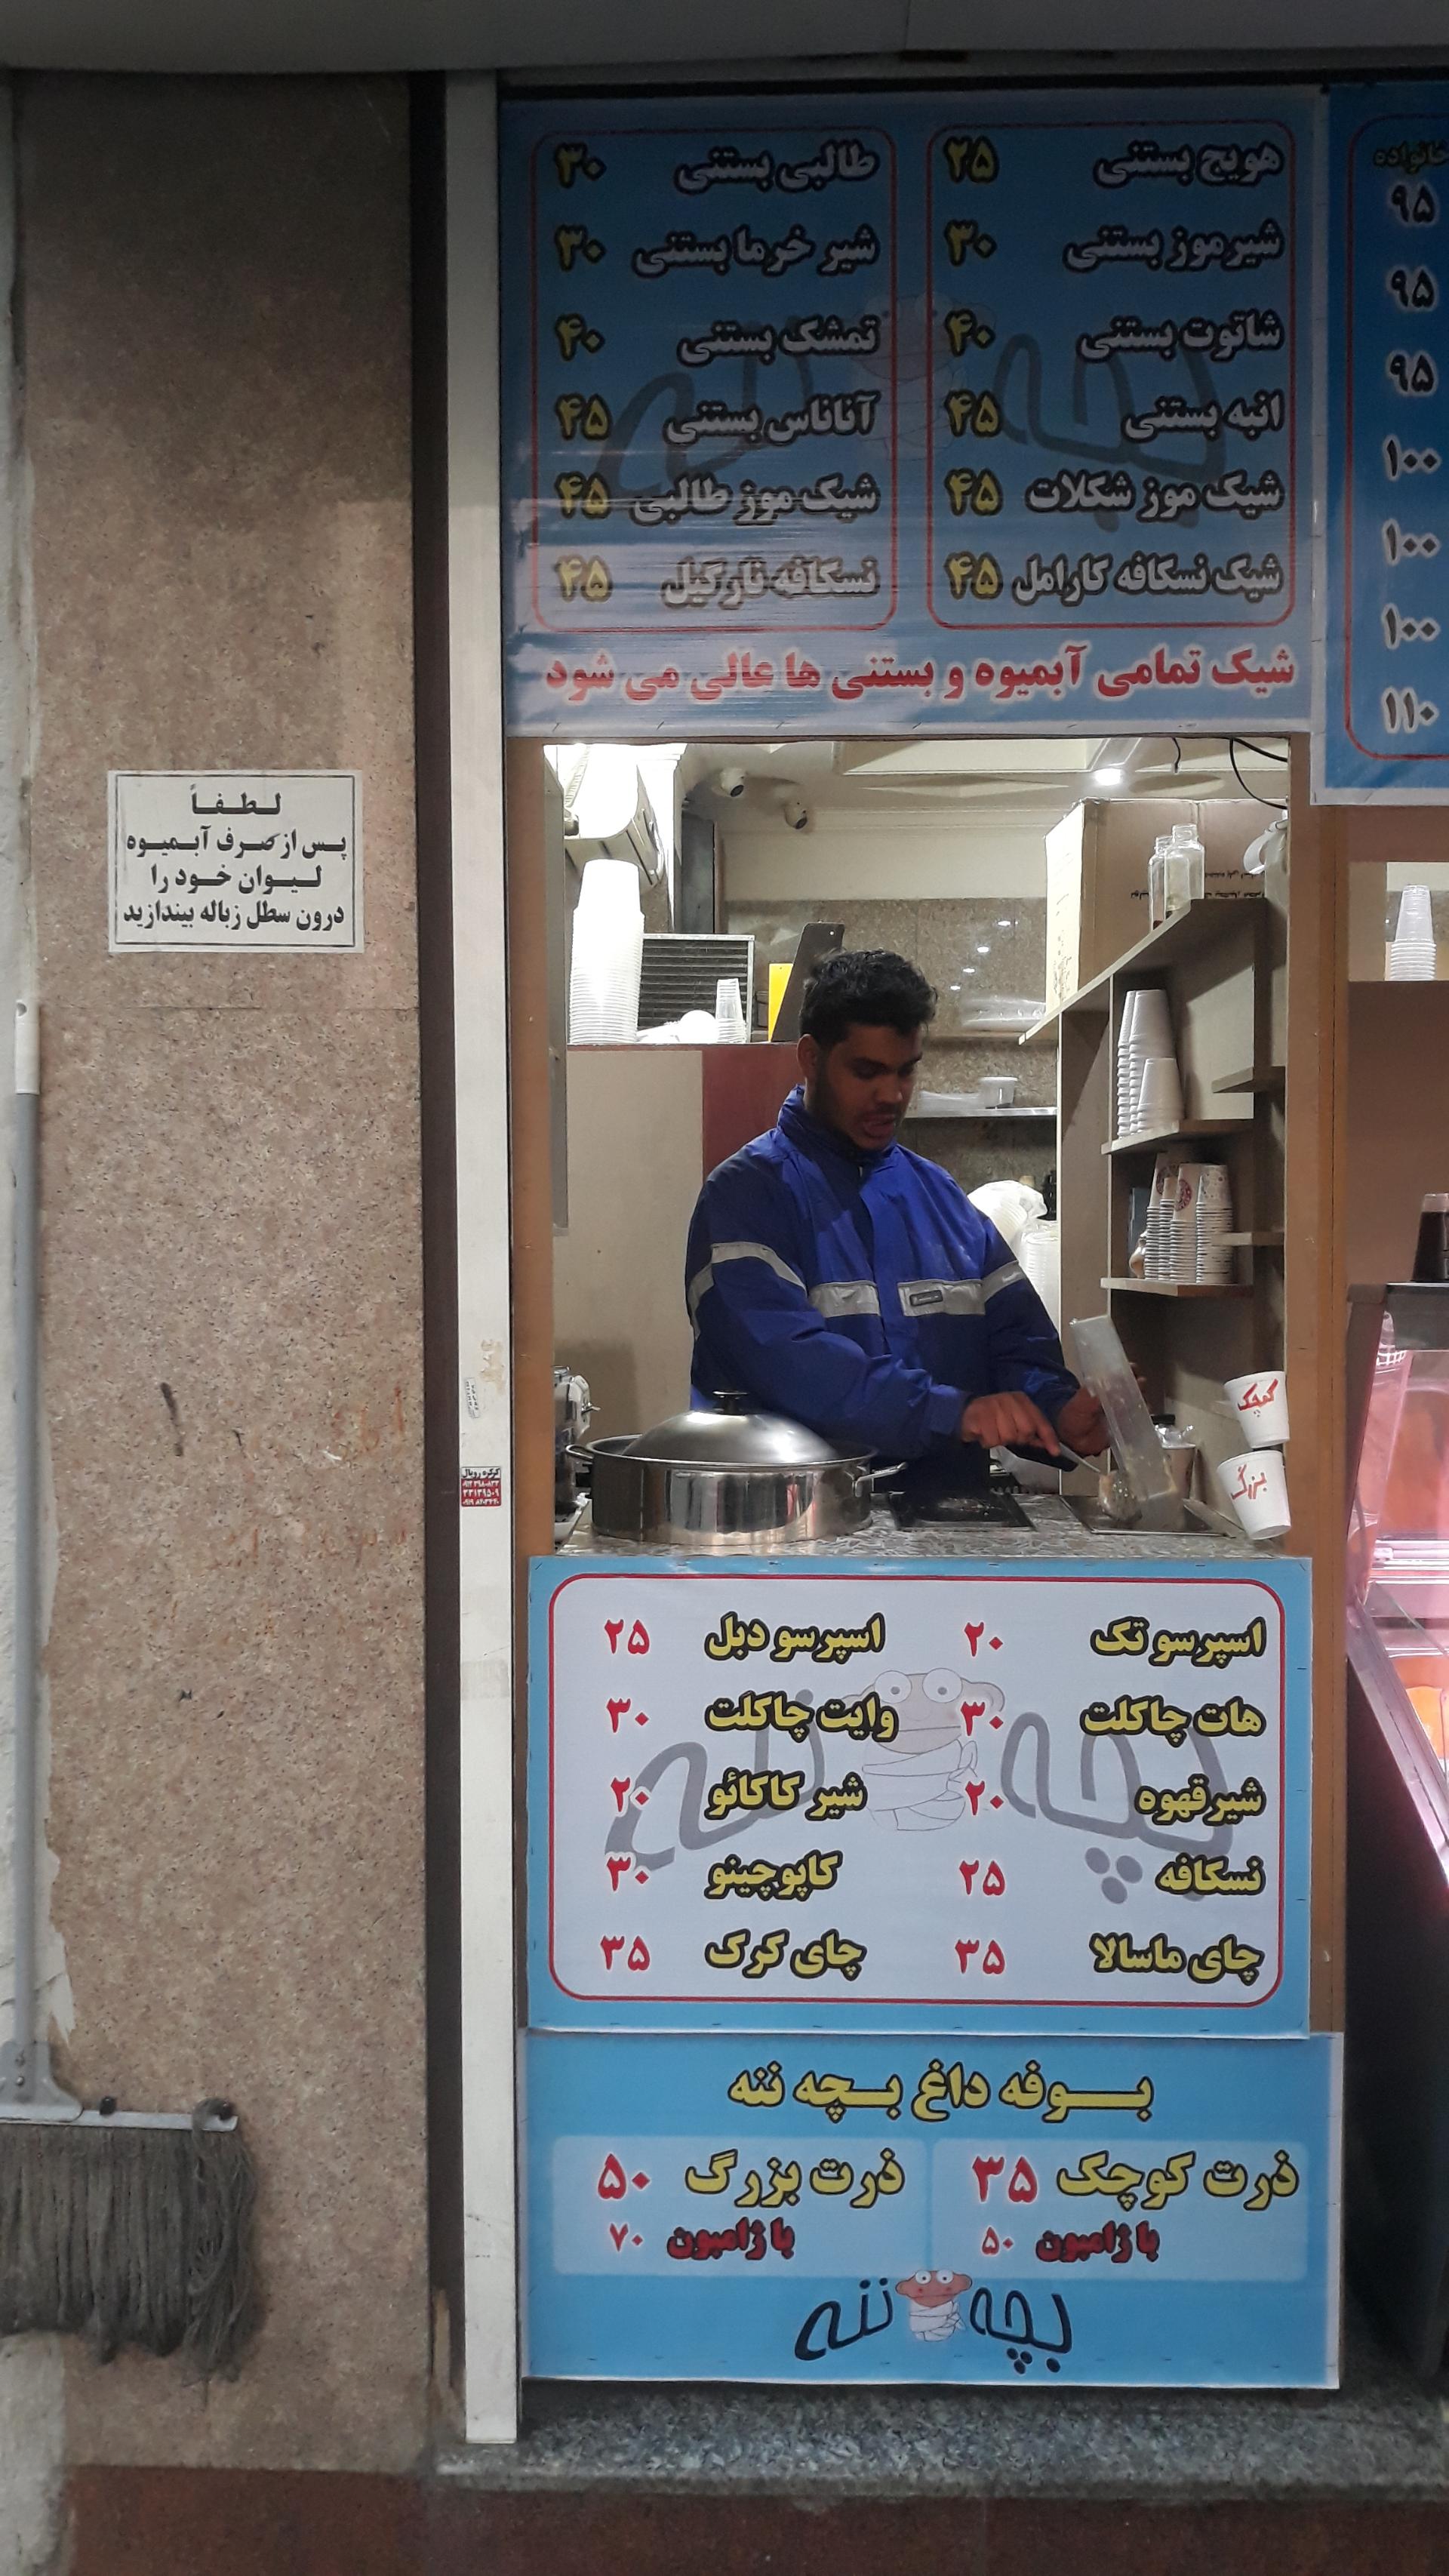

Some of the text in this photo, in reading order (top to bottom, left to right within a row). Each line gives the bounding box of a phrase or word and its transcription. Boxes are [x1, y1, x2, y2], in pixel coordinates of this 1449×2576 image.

[555, 140, 880, 194] طالبی بستنی ۳۰
[944, 137, 1282, 188] هویج بستنی ۲۵
[1387, 181, 1437, 227] ۹۵
[555, 224, 880, 276] شیر خرما بستنی ۳۰
[944, 219, 997, 266] ۳۰
[1063, 224, 1164, 274] بستنی
[1387, 266, 1437, 312] ۹۵
[555, 313, 882, 366] تمشک بستنی ۴۰
[945, 308, 1284, 362] شاتوت بستنی ۴۰
[1387, 349, 1437, 396] ۹۵
[556, 391, 882, 445] آناناس بستنی ۴۵
[945, 390, 1284, 442] انبه بستنی ۴۵
[1381, 436, 1441, 481] ۱۰۰
[555, 471, 882, 525] شیک موز طالبی ۴۵
[945, 469, 1284, 522] شیک موز شکلات ۴۵
[1381, 519, 1441, 565] ۱۰۰
[555, 555, 880, 610] نسکافه نارگیل ۴۵
[945, 549, 1284, 609] شیک نسکافه کارامل ۴۵
[1381, 603, 1441, 649] ۱۰۰
[546, 654, 615, 702] شود
[691, 651, 774, 701] عالی
[785, 651, 822, 689] ها
[831, 655, 935, 701] بستنی
[944, 664, 964, 701] و
[974, 644, 1089, 701] آبمیوه
[1096, 648, 1203, 699] تمامی
[1211, 647, 1295, 697] شیک
[1380, 686, 1438, 733] ۱۱۰
[127, 825, 347, 862] پس از صرف آبمیوه
[151, 864, 322, 894] لیوان خود را
[123, 900, 345, 931] درون سطل زباله بیندازید
[1231, 1463, 1267, 1500] بزرگ
[605, 1611, 887, 1664] اسپرسو دبل ۲۵
[963, 1615, 1266, 1670] اسپرسو تک ۲۰
[606, 1690, 900, 1743] وایت چاکلت ۳۰
[959, 1696, 1266, 1747] هات چاکلت ۳۰
[610, 1770, 869, 1821] شیر کاکائو ۲۰
[964, 1780, 1004, 1817] ۲۰
[606, 1856, 651, 1892] ۳۰
[958, 1854, 1266, 1897] نسکافه ۲۵
[600, 1928, 867, 1980] چای کرک ۳۵
[955, 1931, 1266, 1987] چای ماسالا ۳۵
[727, 2060, 786, 2107] ننه
[792, 2068, 903, 2124] بچه
[911, 2058, 991, 2122] داغ
[597, 2147, 906, 2209] ذرت بزرگ ۵۰
[971, 2150, 1300, 2212] ذرت کوچک ۳۵
[609, 2222, 645, 2253] ۷۰
[770, 2217, 796, 2260] با
[981, 2227, 1014, 2256] ۵۰
[1135, 2221, 1161, 2261] با
[969, 2286, 1072, 2374] بچه
